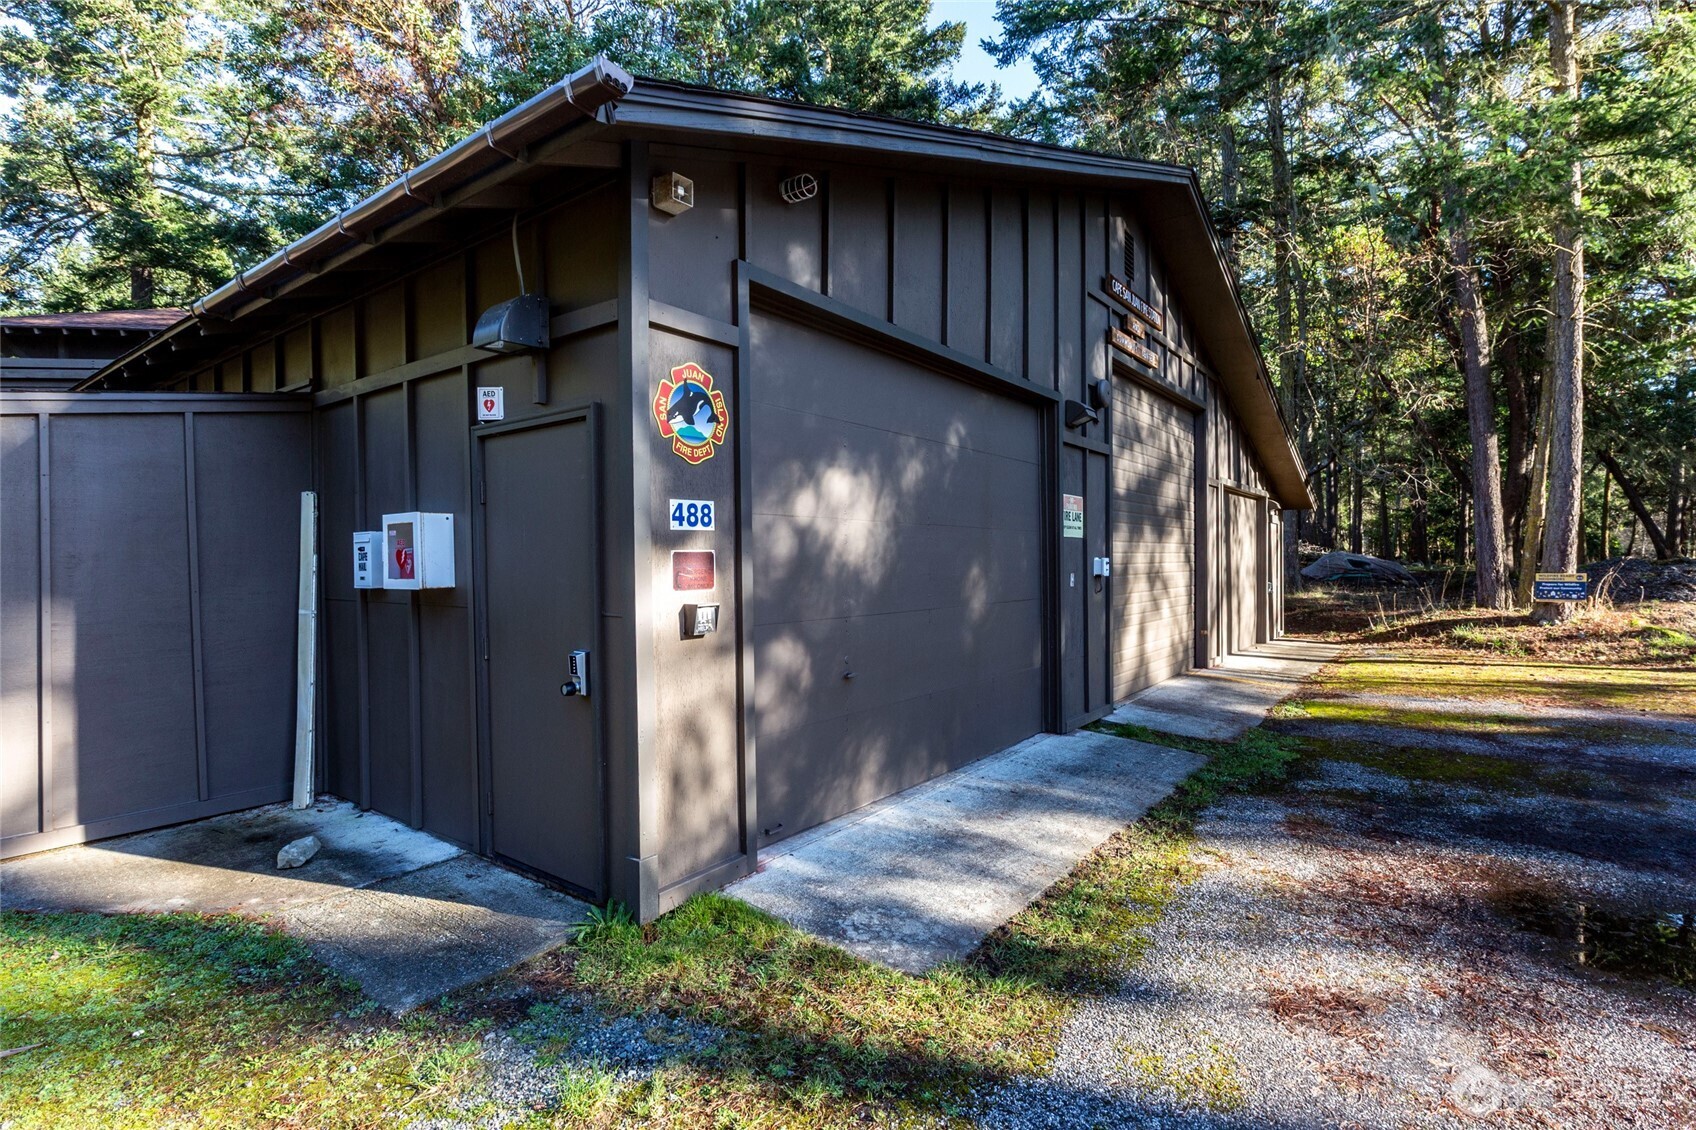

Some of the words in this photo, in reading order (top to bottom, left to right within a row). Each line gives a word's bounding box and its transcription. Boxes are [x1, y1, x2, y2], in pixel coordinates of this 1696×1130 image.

[1112, 279, 1123, 297] CAPE
[1122, 286, 1132, 303] SAN
[1131, 293, 1141, 311] JUAN
[659, 396, 667, 420] SAN
[681, 369, 704, 382] JUAN
[714, 397, 725, 437] ISLAND
[675, 441, 692, 456] FIRE
[693, 444, 711, 457] DEPT
[671, 502, 712, 527] 488
[1072, 512, 1082, 522] LANE
